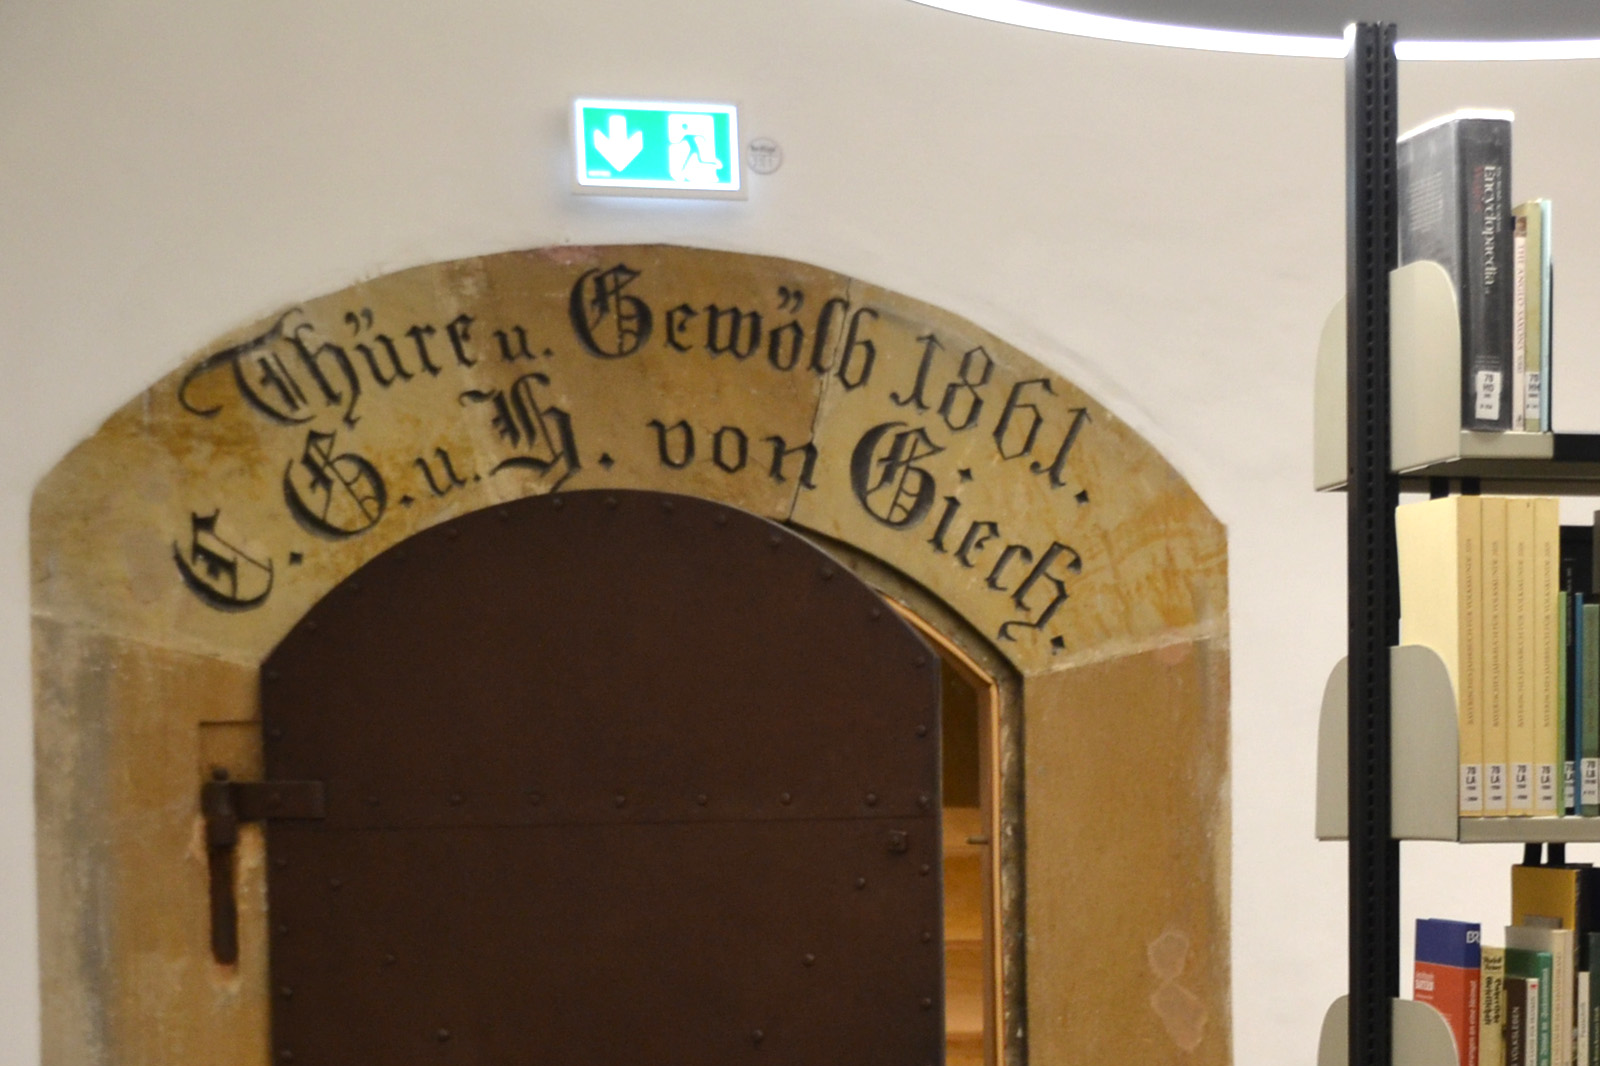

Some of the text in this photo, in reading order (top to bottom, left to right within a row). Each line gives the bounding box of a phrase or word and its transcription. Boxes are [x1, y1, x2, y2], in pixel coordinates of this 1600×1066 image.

[1483, 165, 1496, 286] Encyclopaedia
[178, 264, 1092, 505] Thüre u. Gewölb 1861.
[415, 446, 481, 498] u.
[647, 419, 819, 490] von
[849, 421, 1083, 655] Giech.
